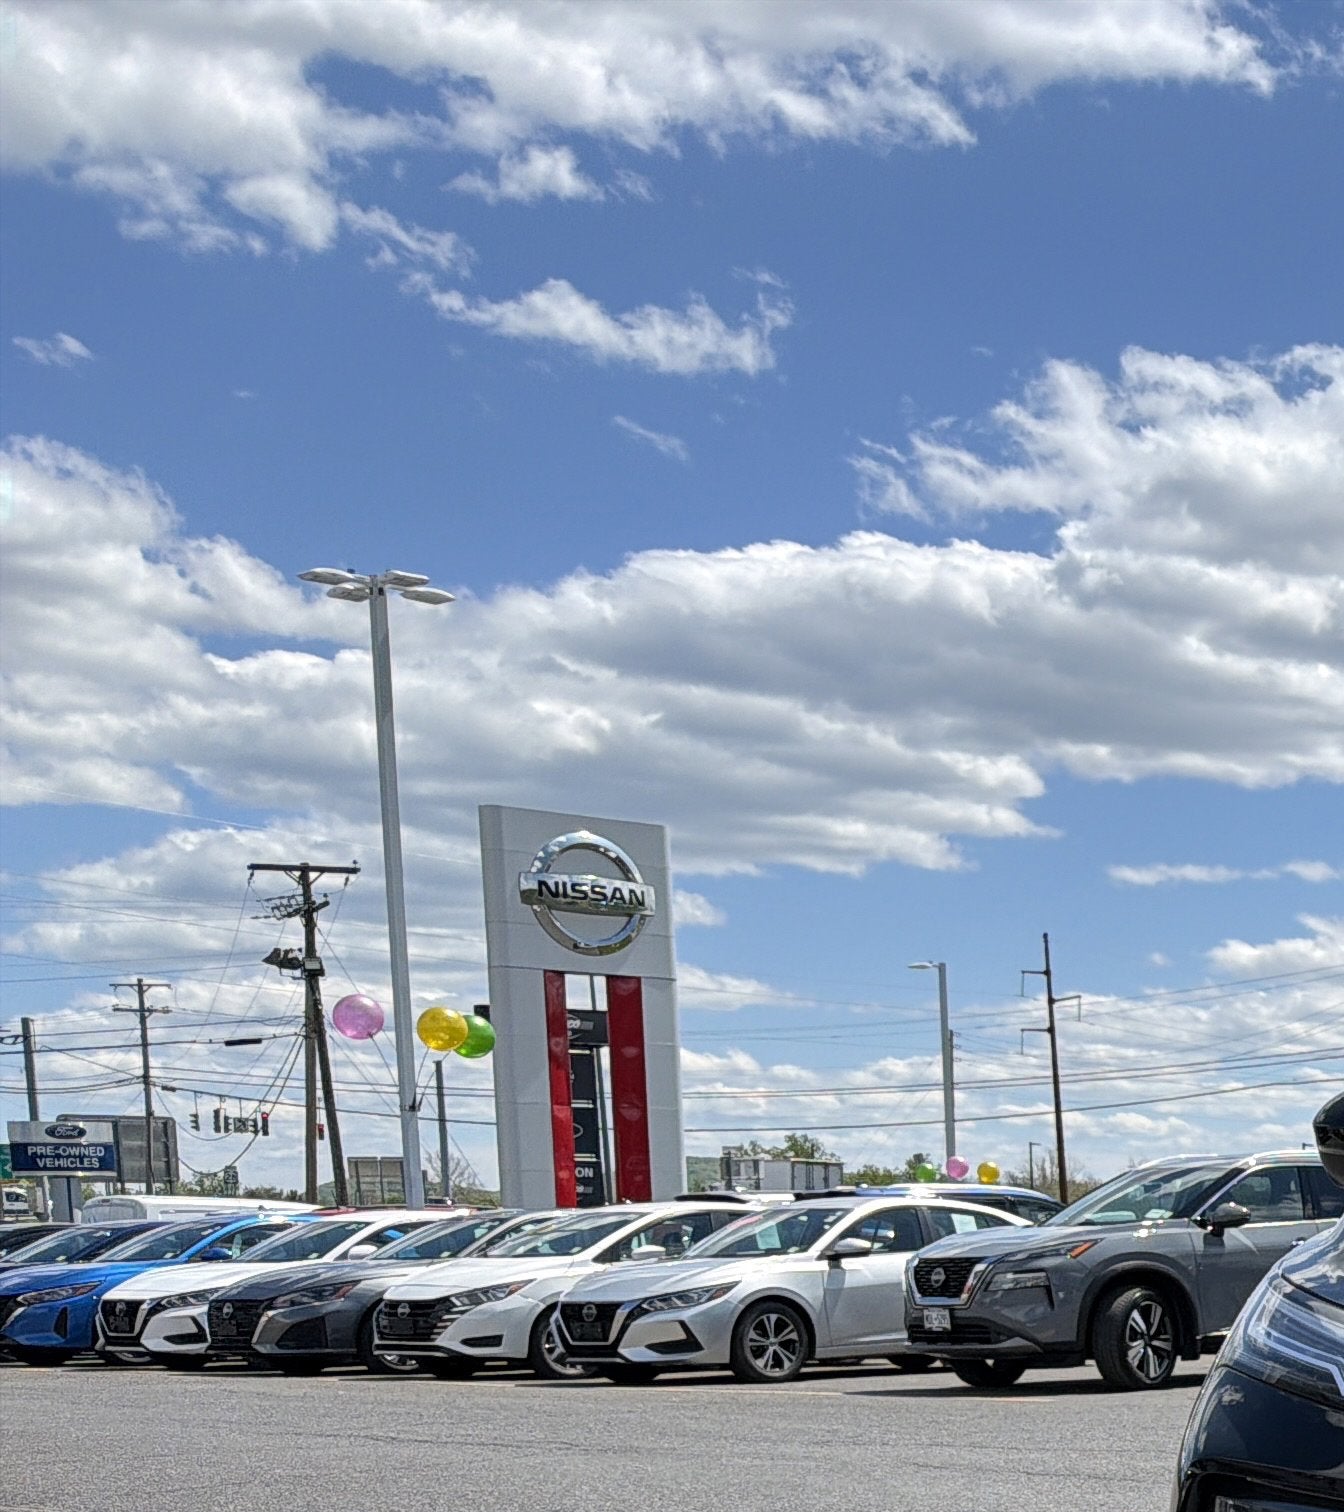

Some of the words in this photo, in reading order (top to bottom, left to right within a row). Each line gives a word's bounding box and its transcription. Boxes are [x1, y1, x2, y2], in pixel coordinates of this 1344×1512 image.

[537, 879, 646, 908] NISSAN
[54, 1127, 79, 1137] Ford
[27, 1145, 105, 1158] PRE-OWNED
[36, 1157, 100, 1169] VEHICLES
